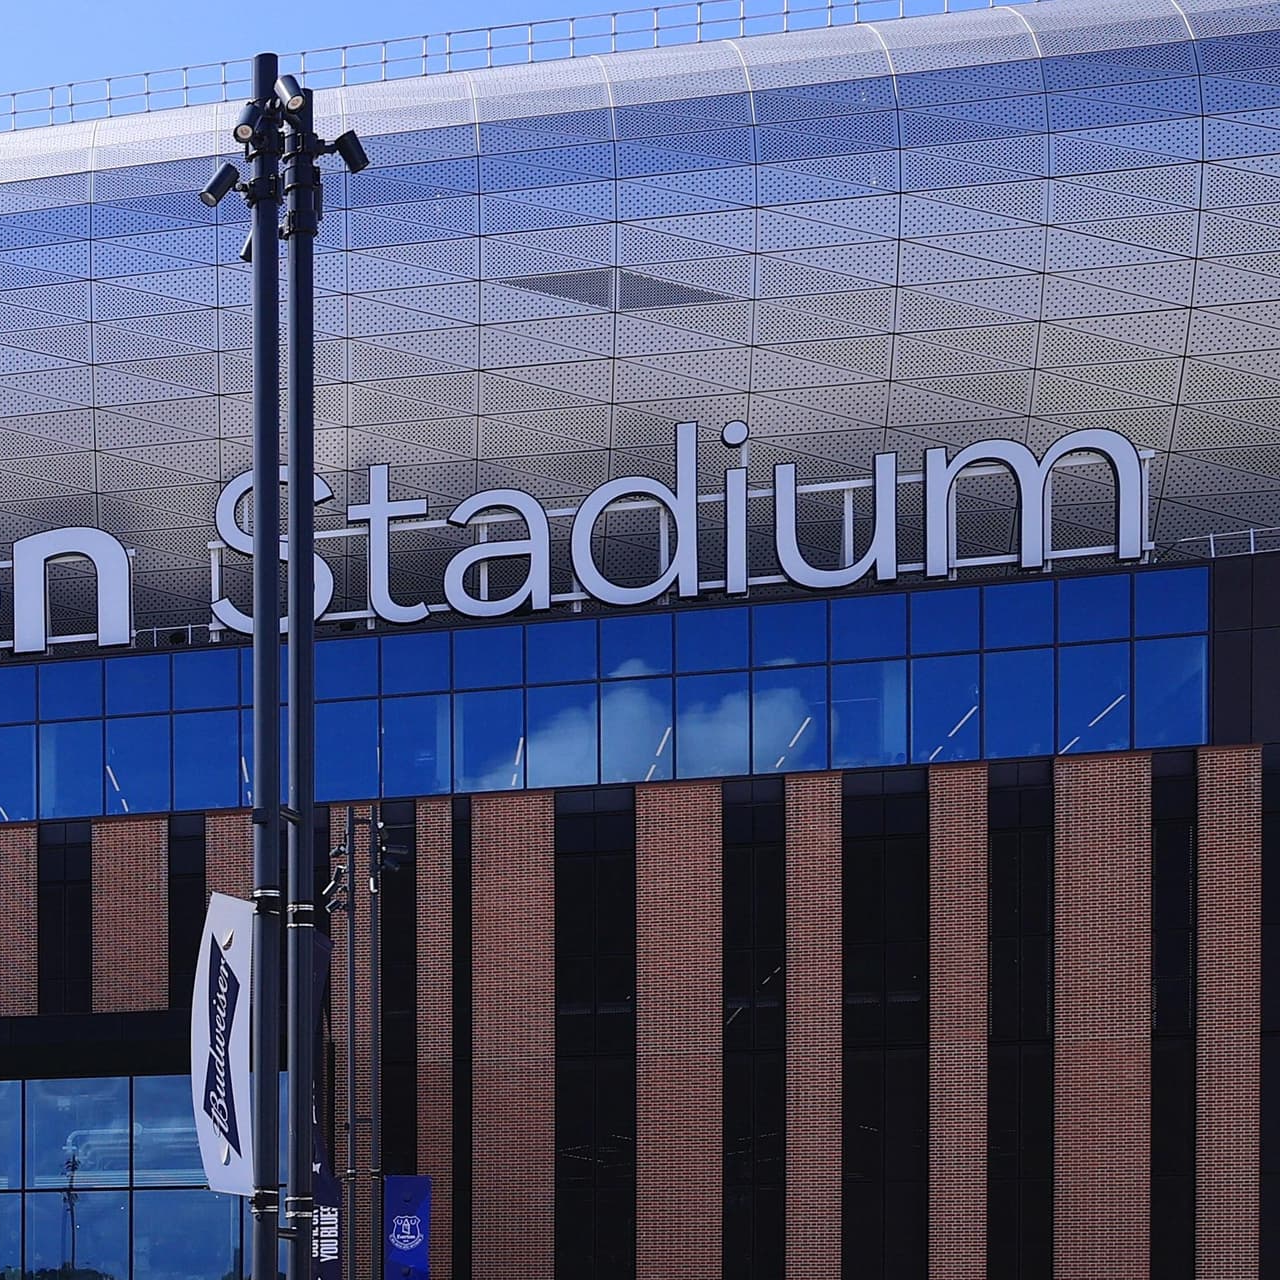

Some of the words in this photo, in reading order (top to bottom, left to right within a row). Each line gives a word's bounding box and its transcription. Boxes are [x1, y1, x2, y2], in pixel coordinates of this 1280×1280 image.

[210, 419, 1144, 636] Stadium
[209, 956, 230, 1140] Budweiser
[320, 1239, 338, 1262] YOU
